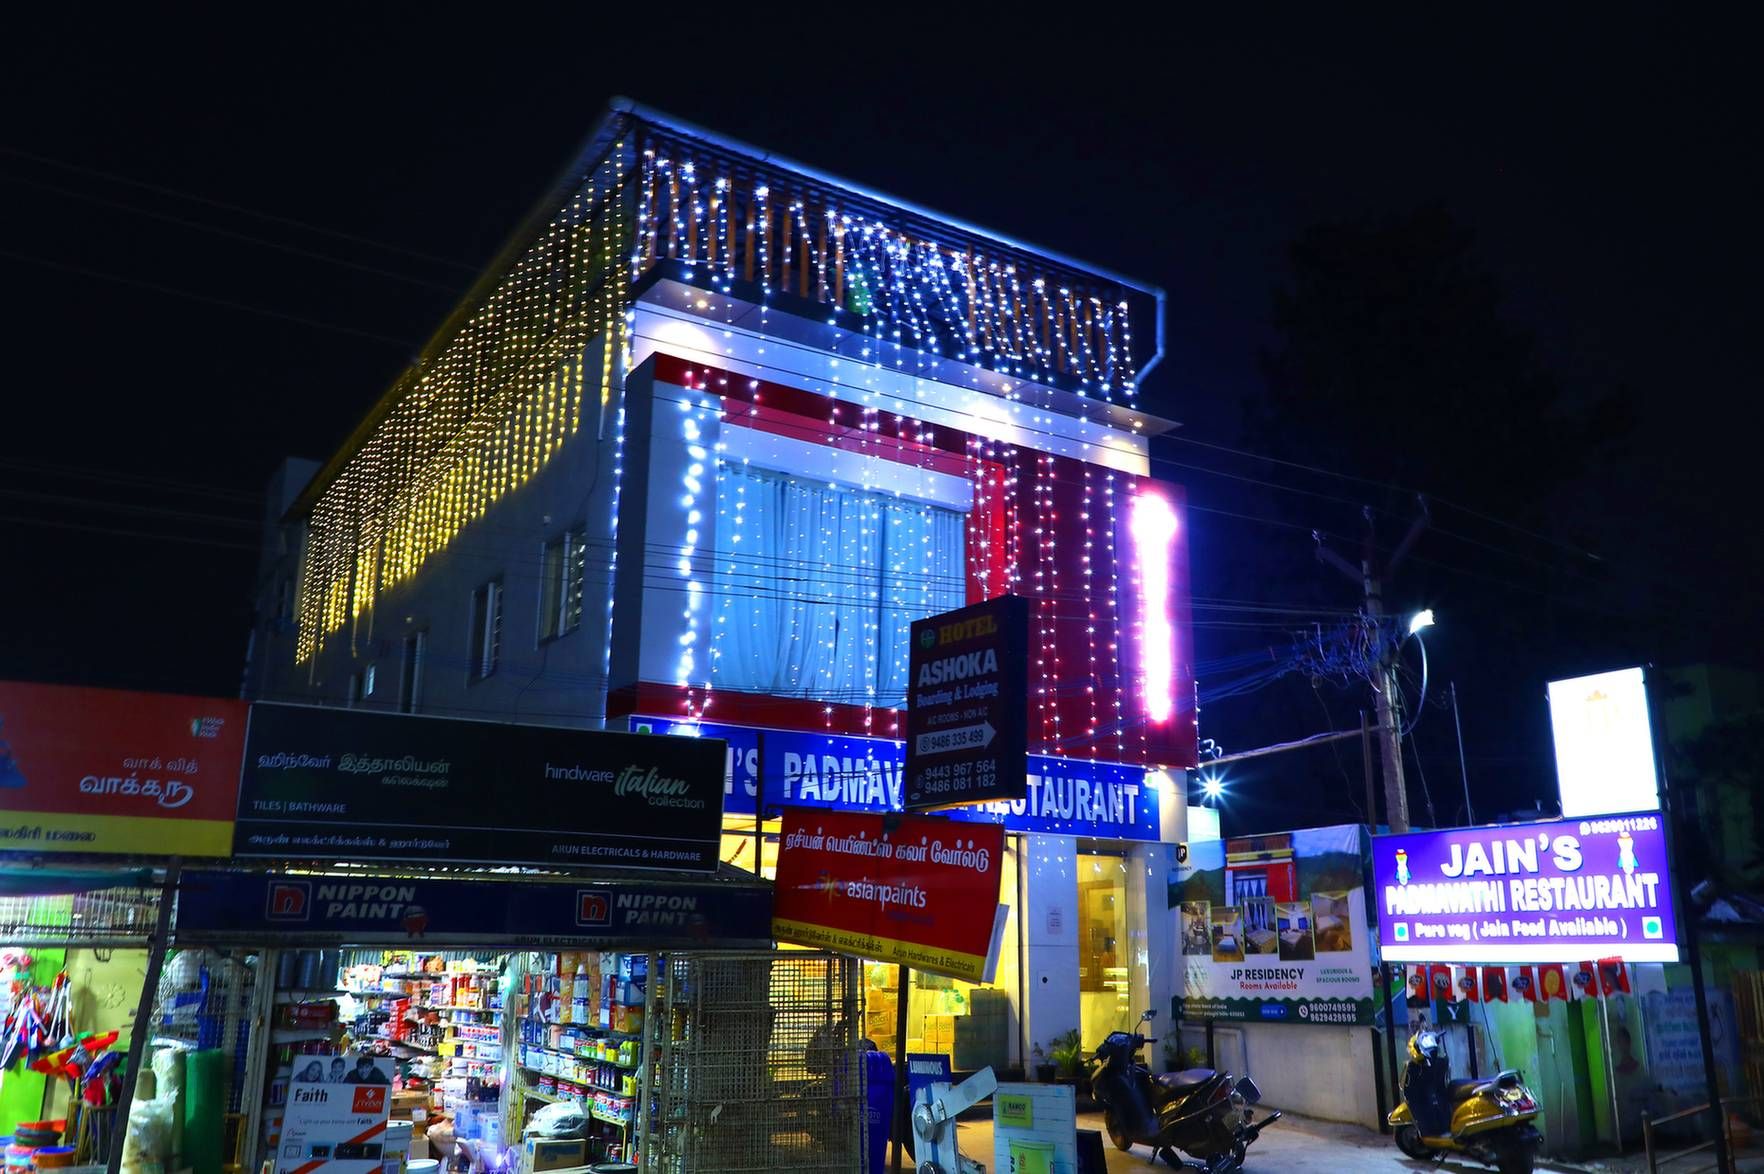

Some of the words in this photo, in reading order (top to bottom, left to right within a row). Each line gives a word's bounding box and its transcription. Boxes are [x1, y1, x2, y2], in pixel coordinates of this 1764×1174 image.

[938, 615, 998, 646] HOTEL
[917, 648, 999, 688] ASHOKA
[932, 735, 951, 749] 9486
[968, 728, 984, 743] 499
[925, 764, 952, 781] 9443
[953, 761, 974, 777] 967
[976, 758, 997, 774] 564
[544, 763, 614, 783] hindware
[614, 764, 690, 798] italian
[925, 778, 952, 795] 9486
[953, 775, 973, 791] 081
[975, 773, 997, 788] 182
[253, 800, 281, 811] TILES
[288, 802, 347, 814] BATHWARE
[648, 794, 705, 810] collection
[551, 843, 579, 855] ARUN
[581, 846, 640, 859] ELECTRICALS
[641, 849, 649, 859] &
[650, 849, 701, 862] HARDWARE
[1440, 832, 1584, 879] JAIN'S
[316, 884, 417, 902] NIPPON
[1510, 872, 1660, 913] RESTAURANT
[325, 902, 403, 919] PAINT
[616, 893, 698, 911] NIPPON
[623, 909, 690, 925] PAINT
[1414, 920, 1446, 938] Pure
[1447, 923, 1471, 941] veg
[1512, 918, 1546, 937] Food
[1548, 916, 1619, 937] Available
[1230, 968, 1243, 981] JP
[1244, 968, 1305, 980] RESIDENCY
[1239, 981, 1262, 991] Rooms
[1264, 981, 1298, 991] Available
[909, 1060, 943, 1075] LUMINOUS
[295, 1088, 328, 1103] Faith
